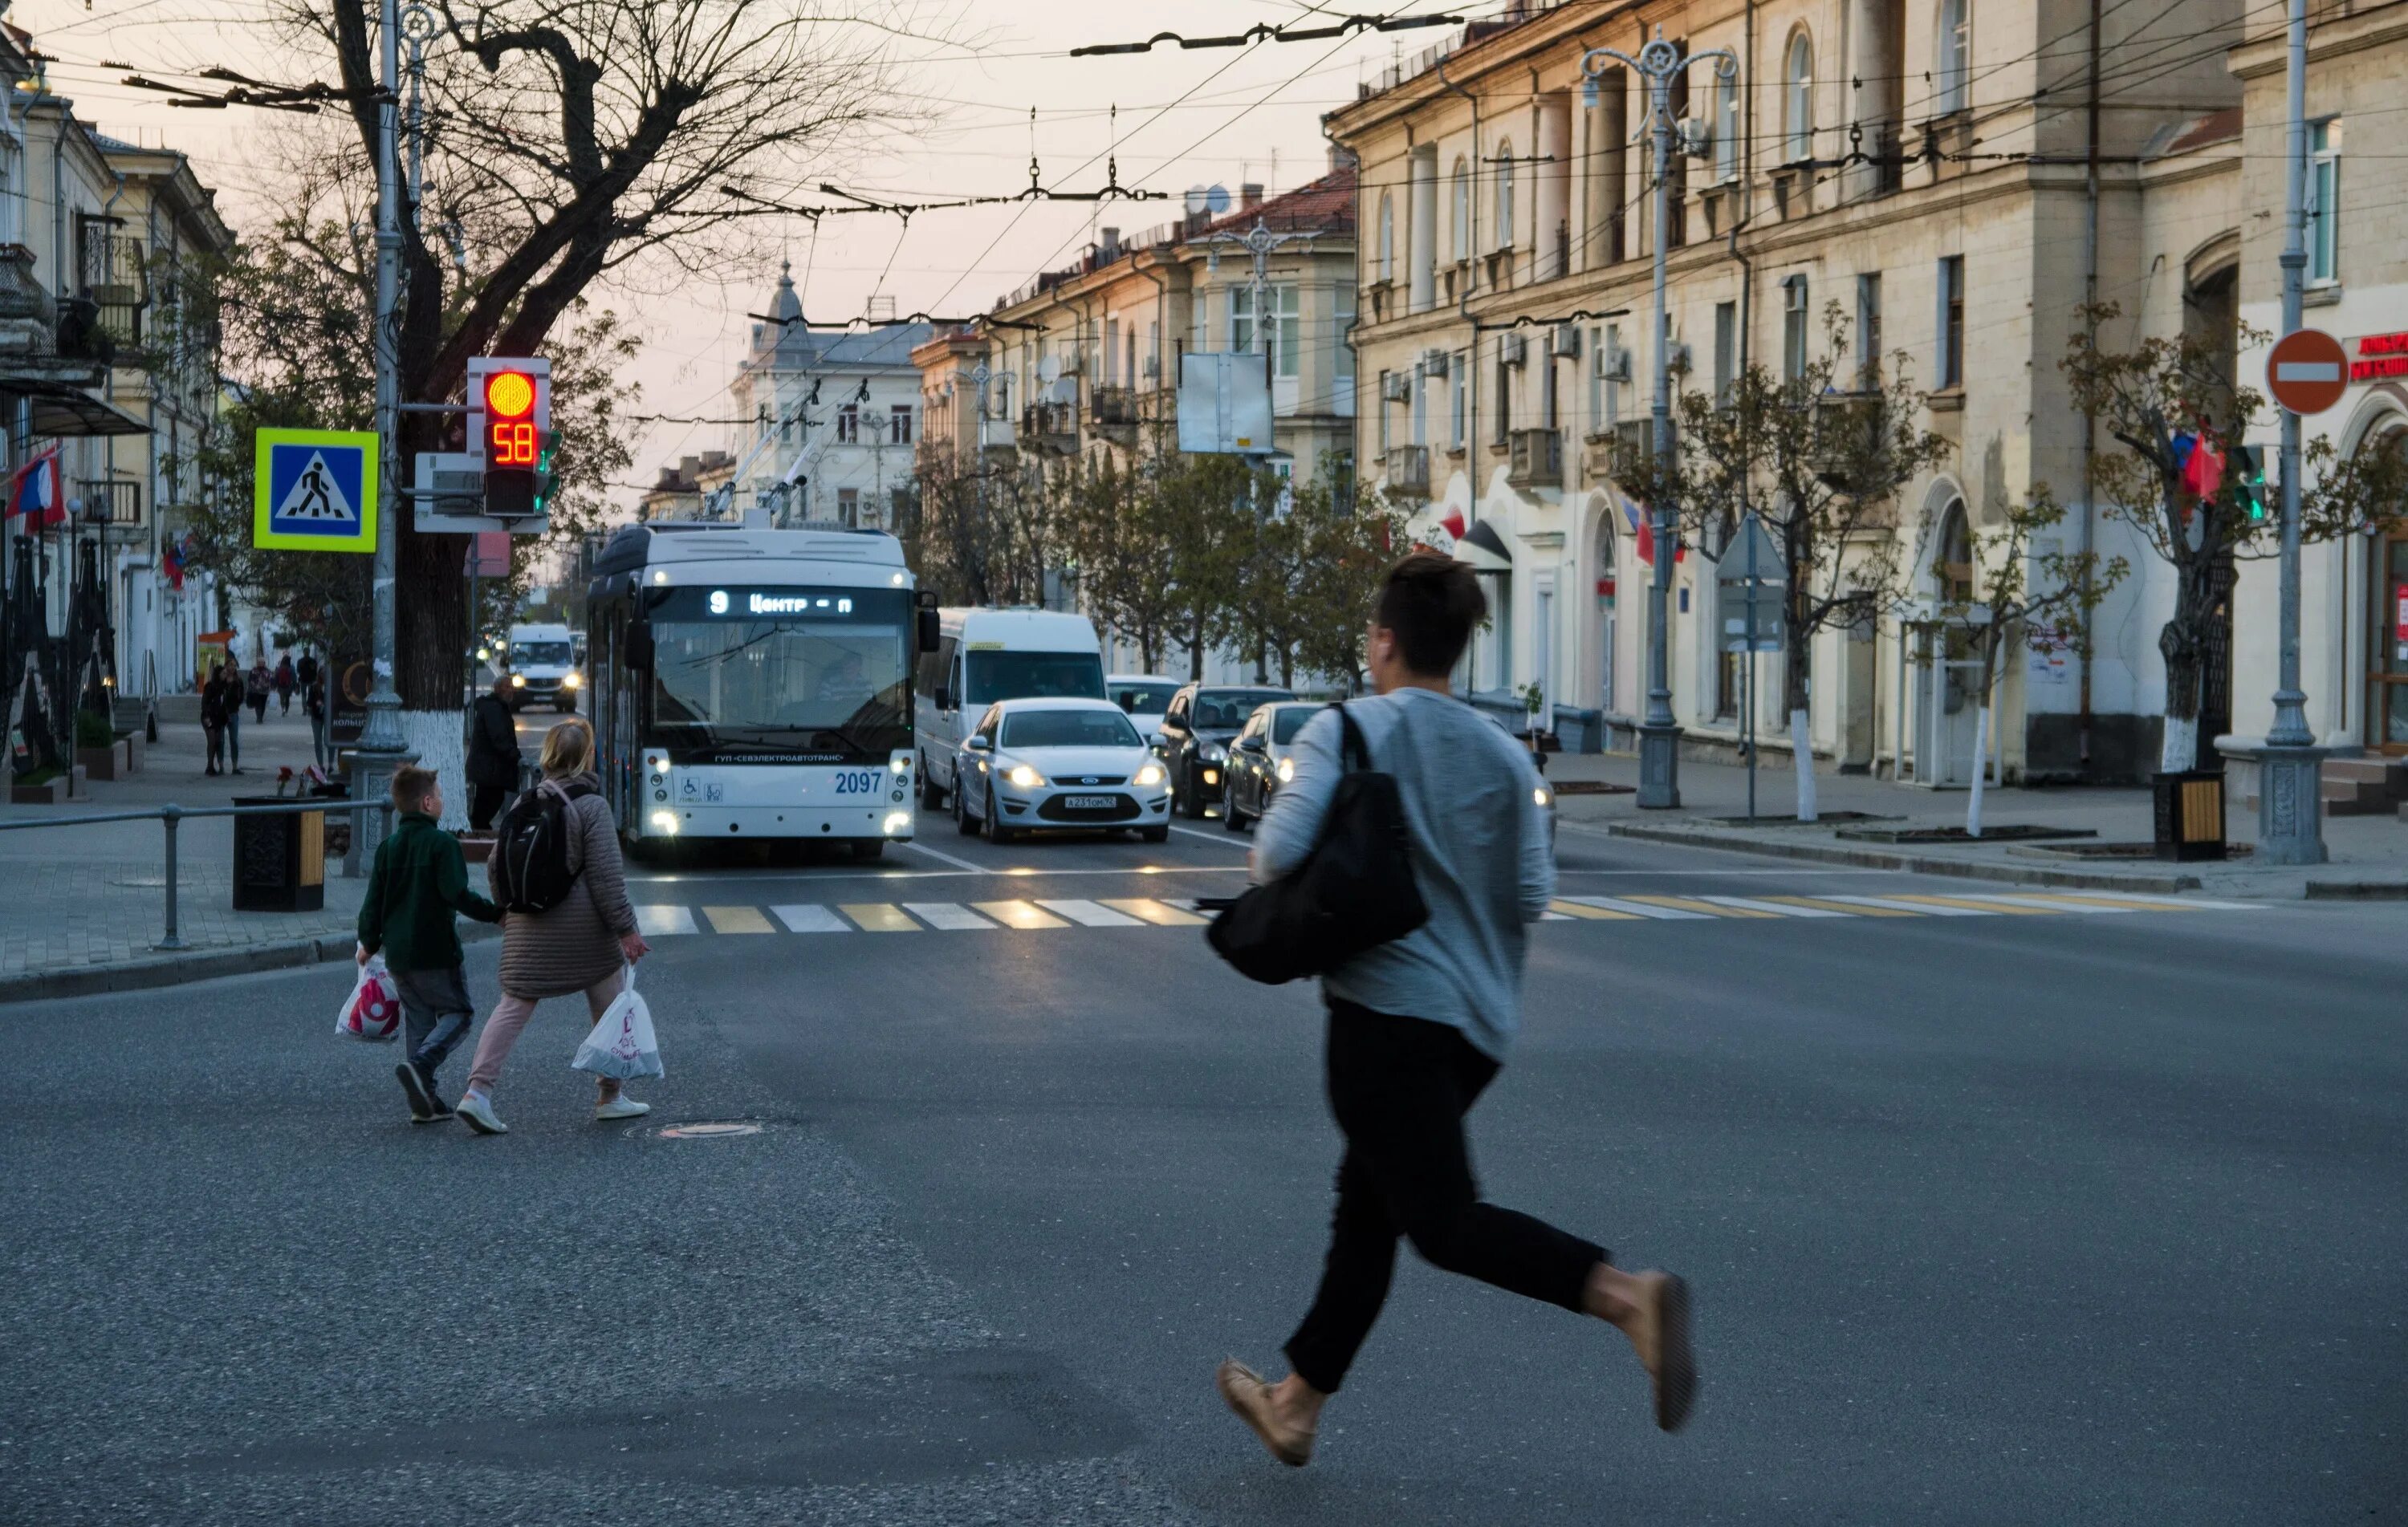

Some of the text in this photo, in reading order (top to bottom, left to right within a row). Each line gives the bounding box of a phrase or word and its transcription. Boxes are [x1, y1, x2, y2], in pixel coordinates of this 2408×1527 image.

[494, 424, 534, 462] 58
[710, 590, 729, 614] 9
[835, 772, 882, 794] 2097
